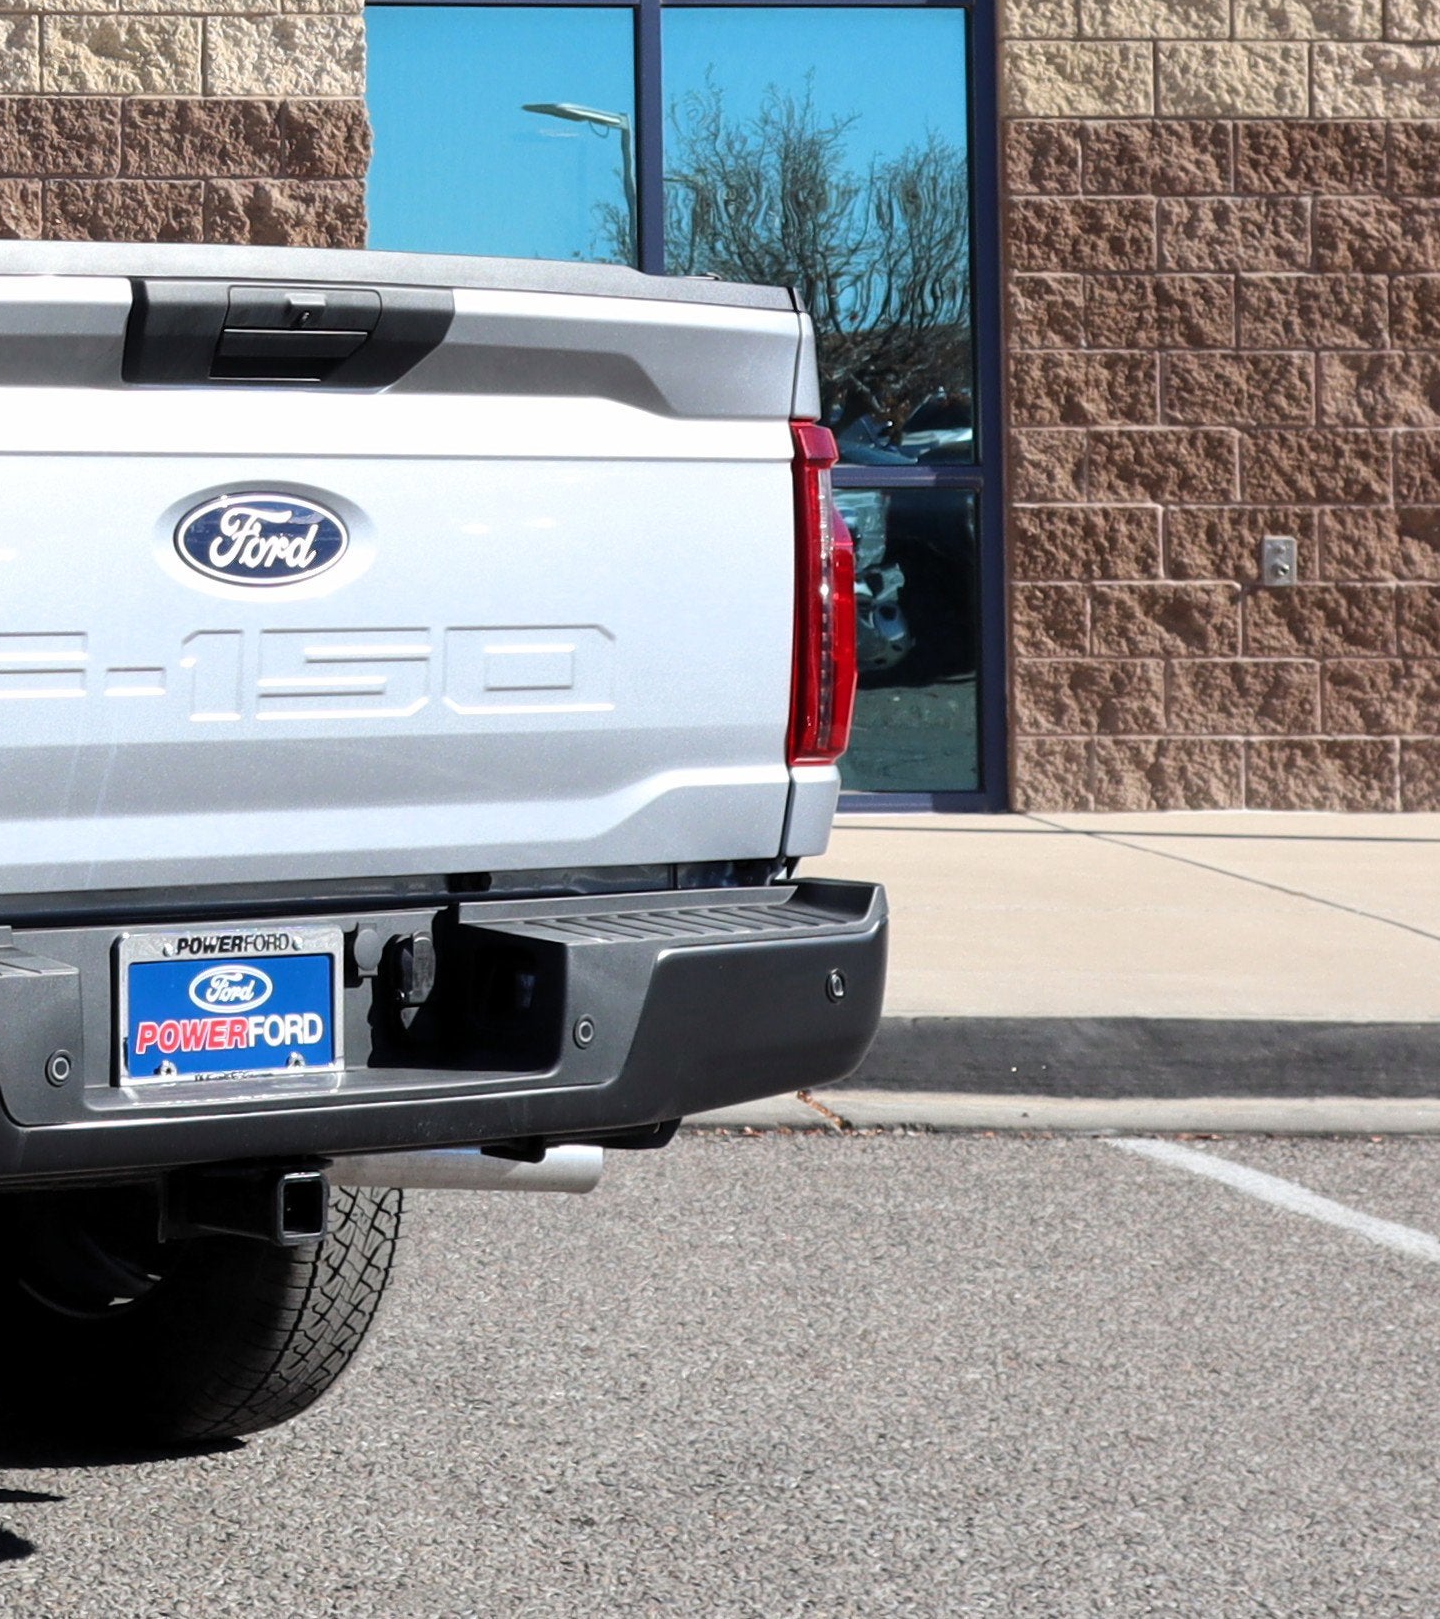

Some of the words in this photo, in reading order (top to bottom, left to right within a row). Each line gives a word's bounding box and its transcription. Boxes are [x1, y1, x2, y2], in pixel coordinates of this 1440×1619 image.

[208, 506, 318, 568] Ford
[176, 933, 289, 955] POWERFORD
[205, 973, 256, 1002] Ford
[136, 1013, 323, 1054] POWERFORD
